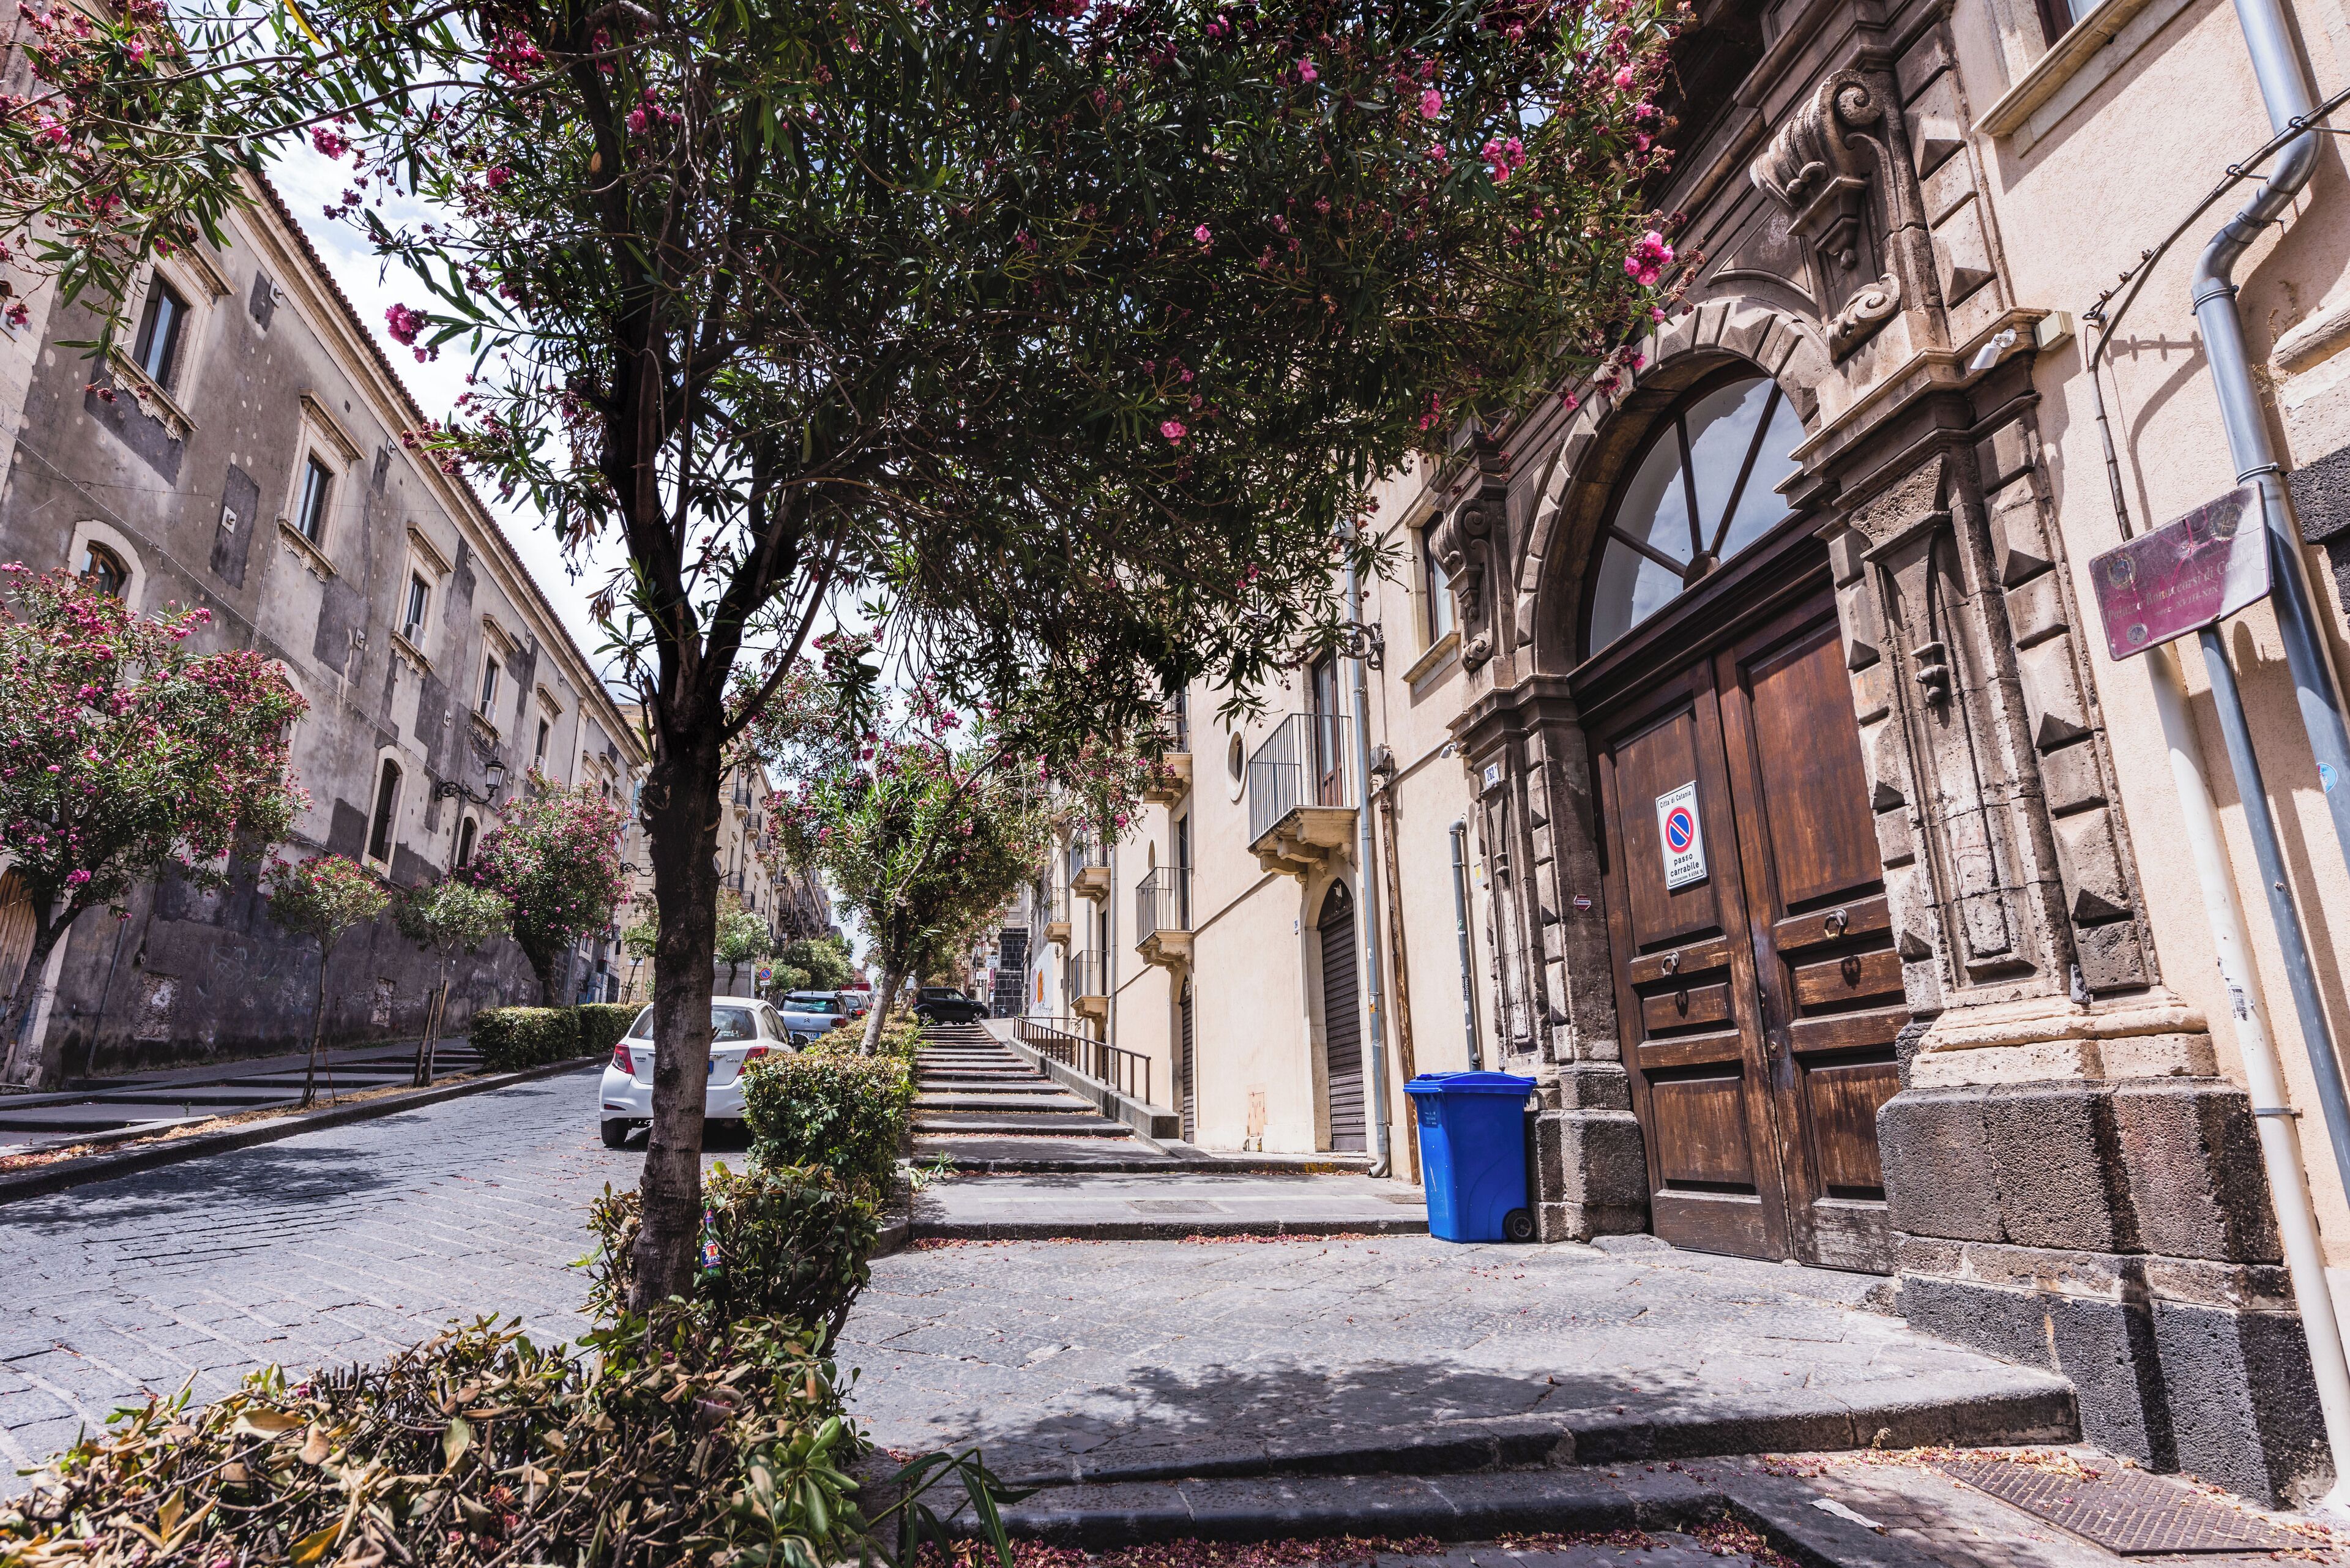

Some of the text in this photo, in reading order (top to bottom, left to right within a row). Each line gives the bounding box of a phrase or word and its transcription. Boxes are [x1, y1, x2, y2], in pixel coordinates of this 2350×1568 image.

[2204, 566, 2214, 581] di
[1676, 790, 1691, 801] Catania
[1674, 853, 1693, 867] passo
[1670, 861, 1699, 877] carrabile
